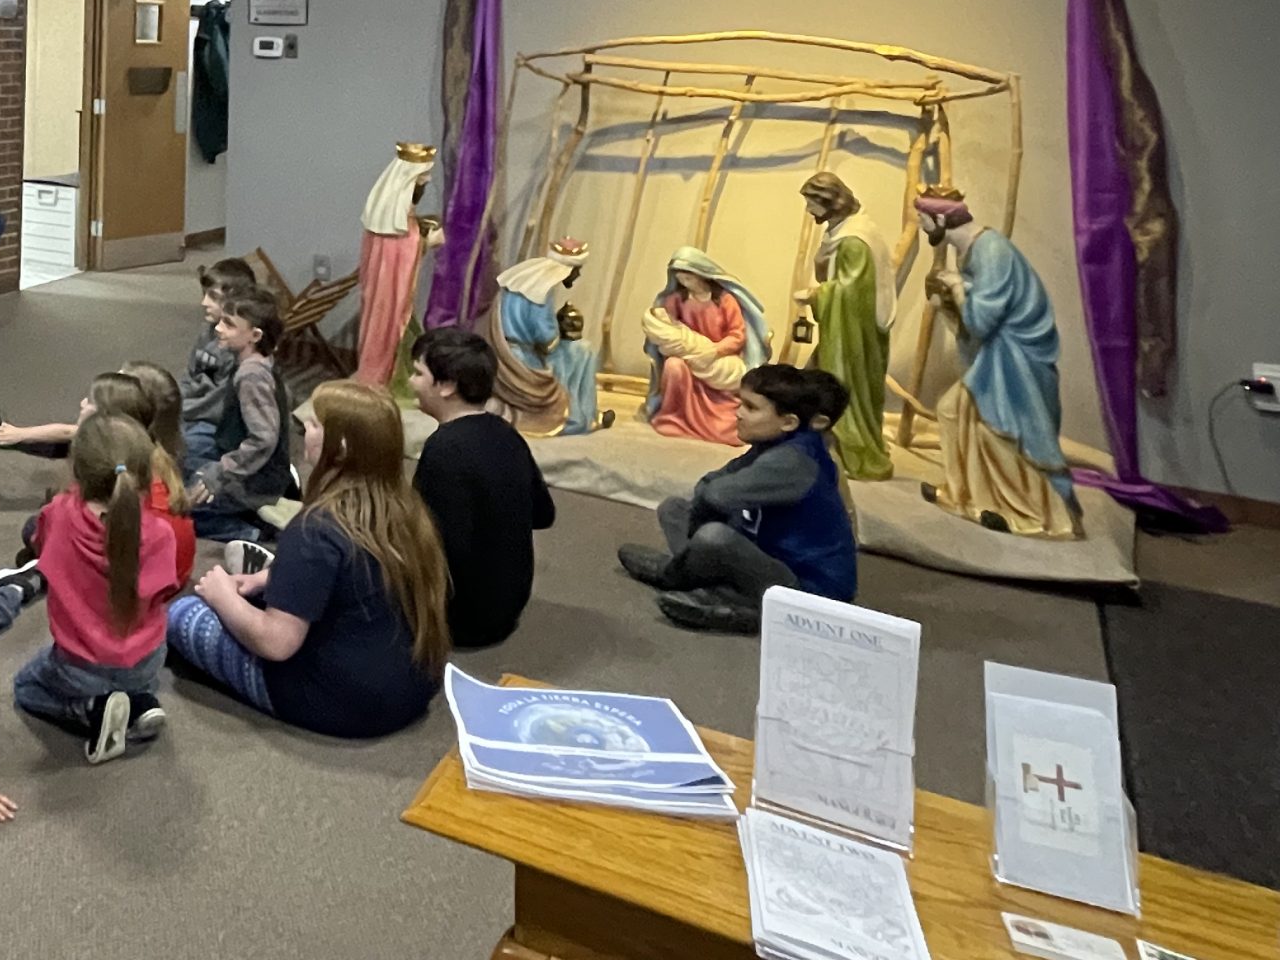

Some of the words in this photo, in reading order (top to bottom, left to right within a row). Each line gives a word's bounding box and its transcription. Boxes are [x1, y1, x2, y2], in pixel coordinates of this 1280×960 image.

[784, 613, 844, 640] ADVENT
[850, 630, 882, 647] ONE
[541, 694, 590, 706] TIERRA
[594, 702, 643, 727] ESPERA
[770, 821, 831, 849] ADVENT
[839, 843, 876, 861] TWO
